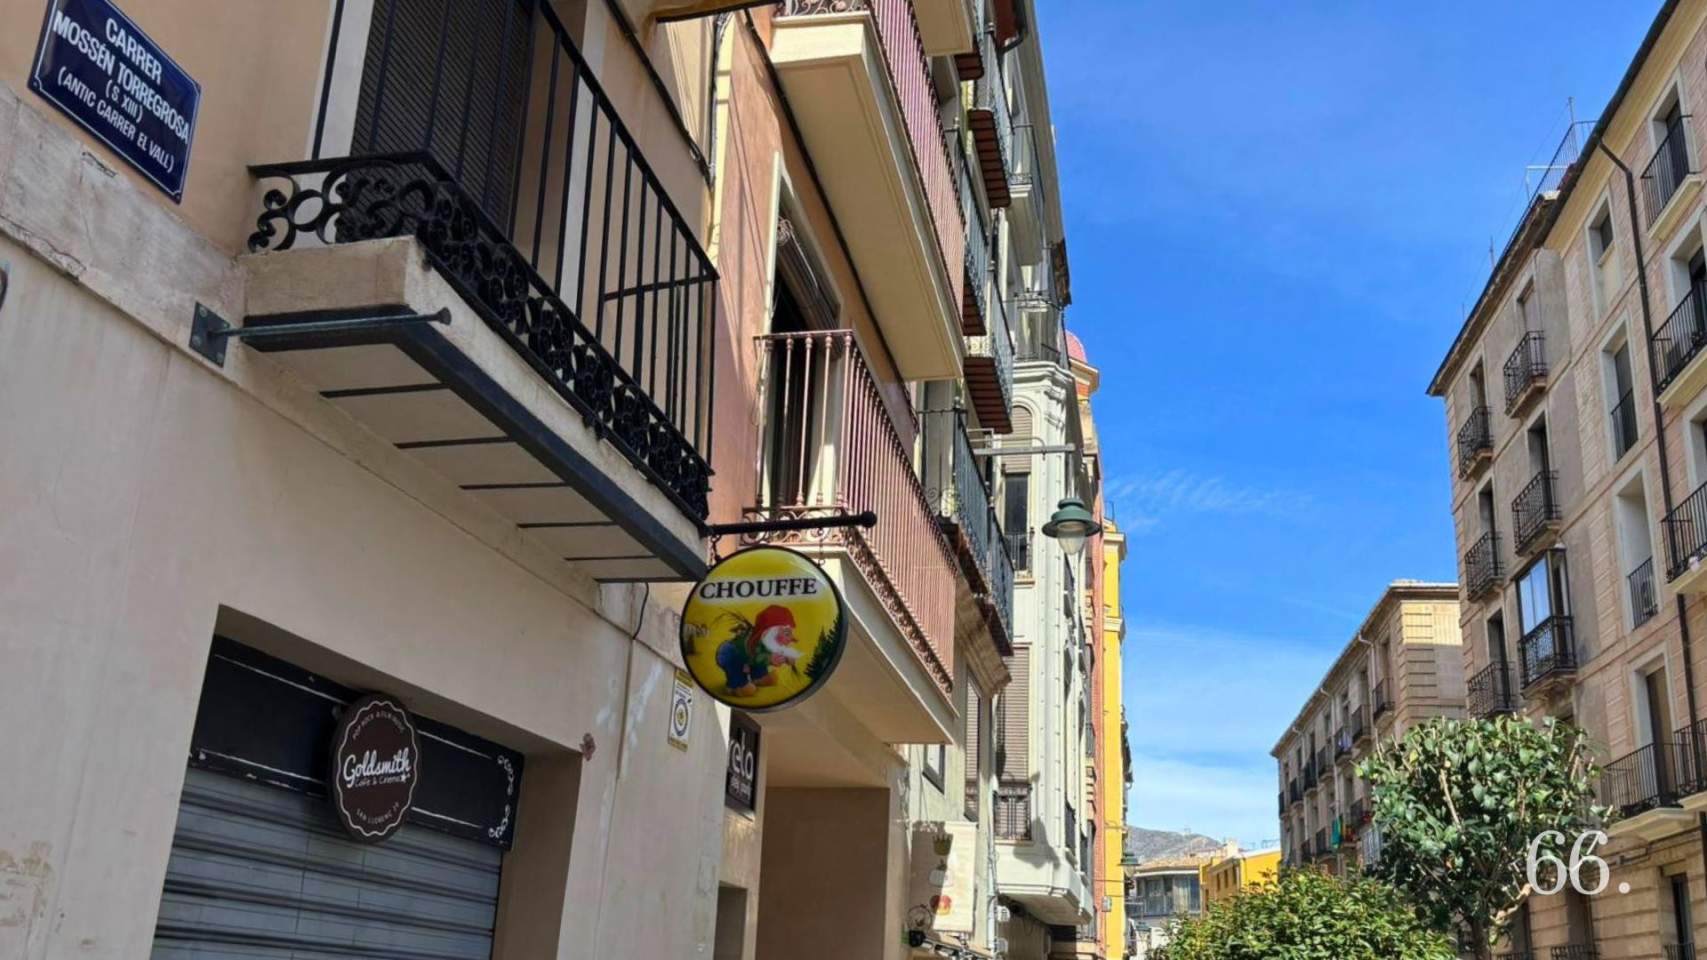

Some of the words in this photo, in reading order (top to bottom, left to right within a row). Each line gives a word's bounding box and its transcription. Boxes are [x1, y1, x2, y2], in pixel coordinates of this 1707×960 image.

[53, 10, 116, 76] MOSSÉN
[117, 62, 190, 145] TORREGROSA
[105, 18, 162, 84] CARRER
[57, 66, 97, 107] (ANTIC
[96, 101, 136, 140] CARRER
[136, 132, 149, 152] EL
[148, 142, 176, 174] VALL)
[121, 95, 143, 123] XIII)
[699, 577, 818, 600] CHOUFFE
[343, 747, 412, 789] Goldsmith
